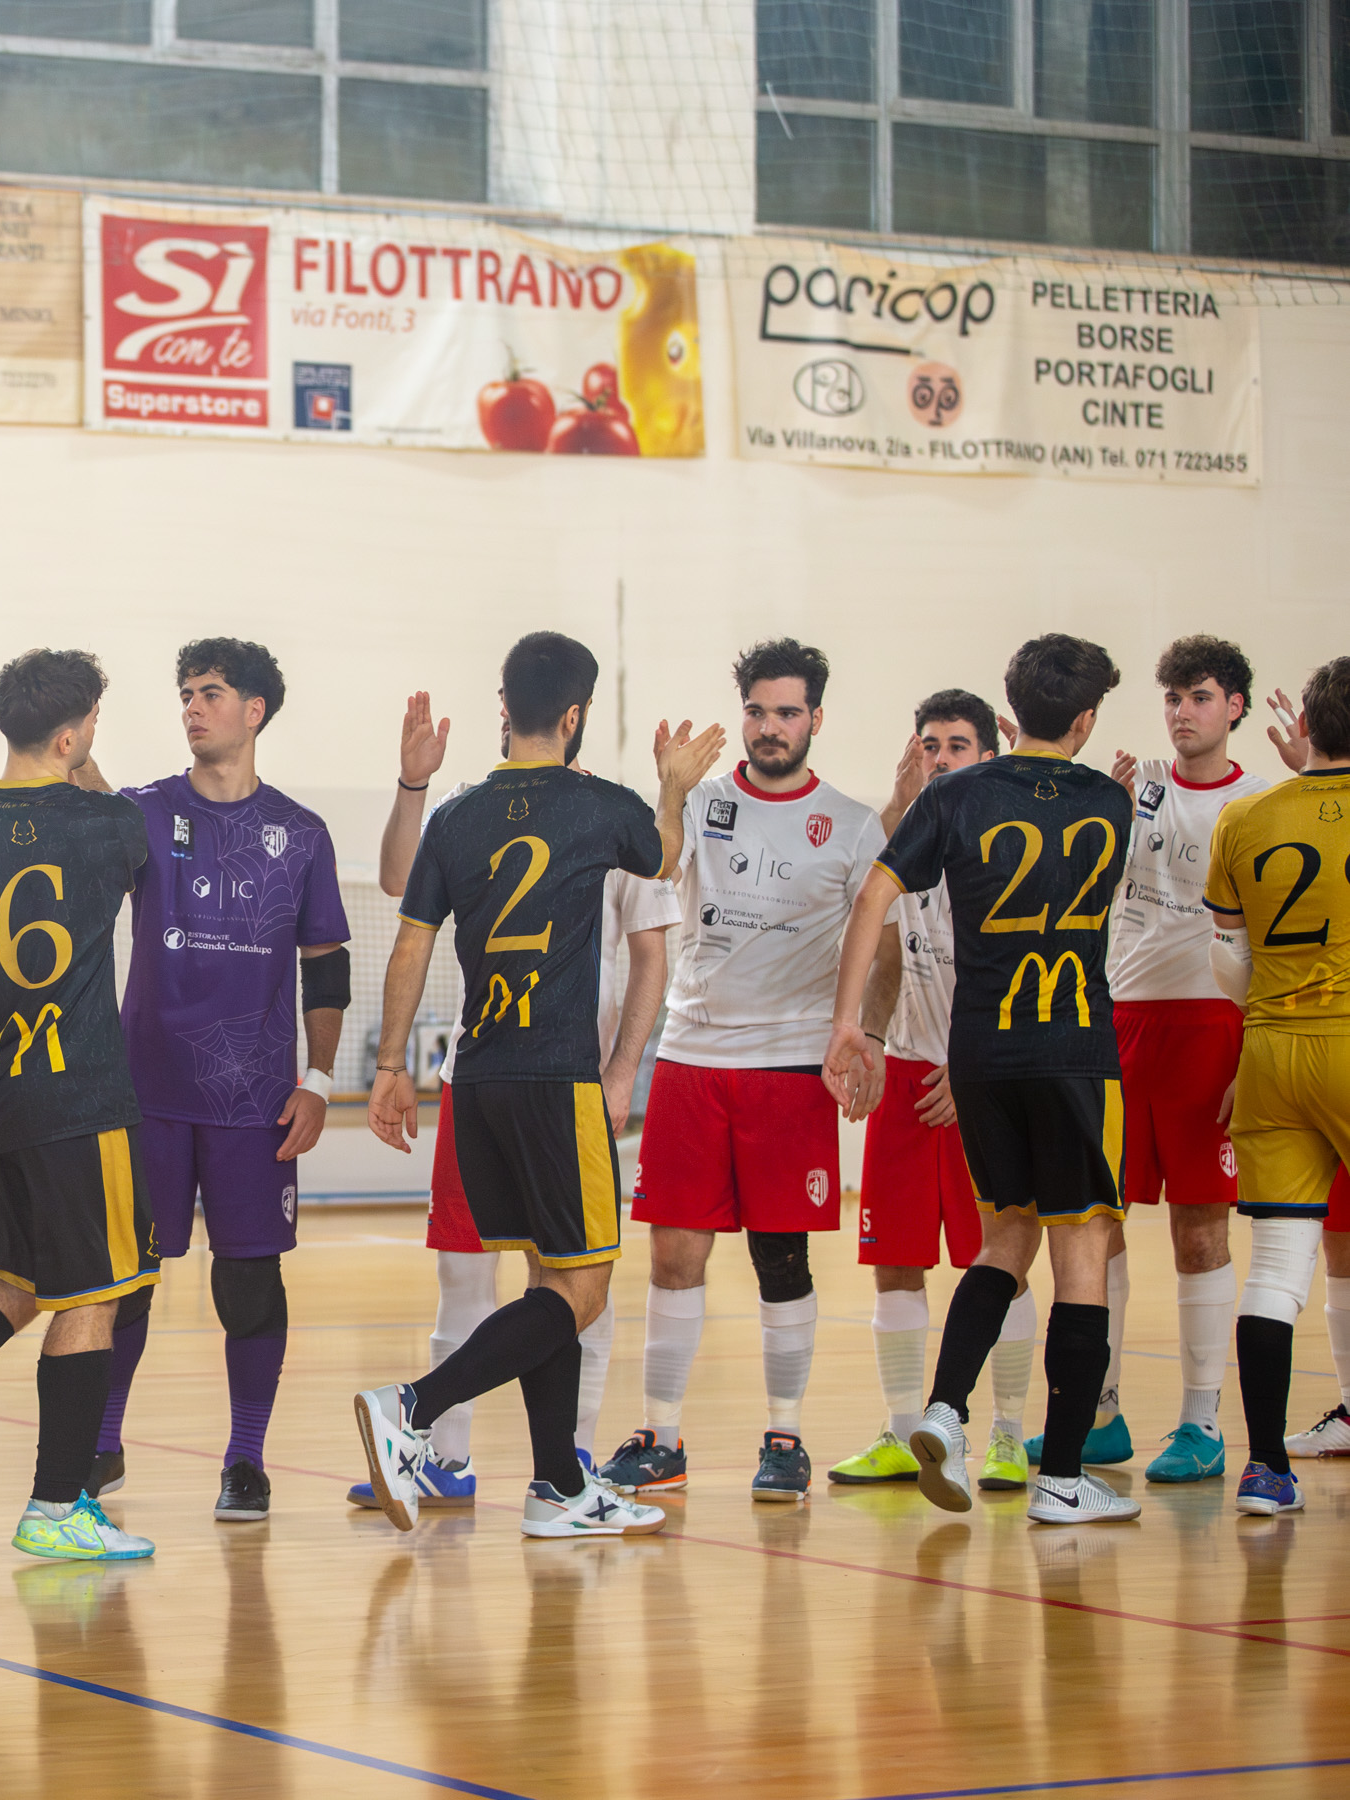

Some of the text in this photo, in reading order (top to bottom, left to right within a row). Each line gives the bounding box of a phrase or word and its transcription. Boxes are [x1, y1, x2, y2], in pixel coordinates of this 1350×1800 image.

[293, 237, 623, 312] FILOTTRANO
[759, 263, 996, 344] paricop
[1031, 280, 1223, 320] PELLETTERIA
[291, 301, 418, 335] via Fonti, 3
[153, 326, 253, 369] con te
[1076, 322, 1175, 355] BORSE
[1034, 357, 1214, 395] PORTAFOGLI
[106, 383, 261, 419] Superstore
[1082, 398, 1166, 430] CINTE
[746, 425, 776, 447] Via
[781, 428, 883, 456] Villanova,
[929, 439, 1046, 465] FILOTTRANO
[1051, 444, 1093, 469] (AN)
[1098, 445, 1132, 467] Tel.
[1135, 448, 1167, 469] 071
[1173, 449, 1248, 473] 7223455
[769, 859, 794, 881] IC
[1177, 842, 1200, 863] IC
[231, 880, 254, 899] IC
[979, 816, 1117, 935] 22
[484, 835, 553, 954] 2
[1253, 842, 1350, 947] 2
[188, 931, 231, 942] RISTORANTE
[721, 916, 758, 931] Locanda
[187, 938, 273, 956] Locanda Cantalupo
[861, 1207, 872, 1233] 5
